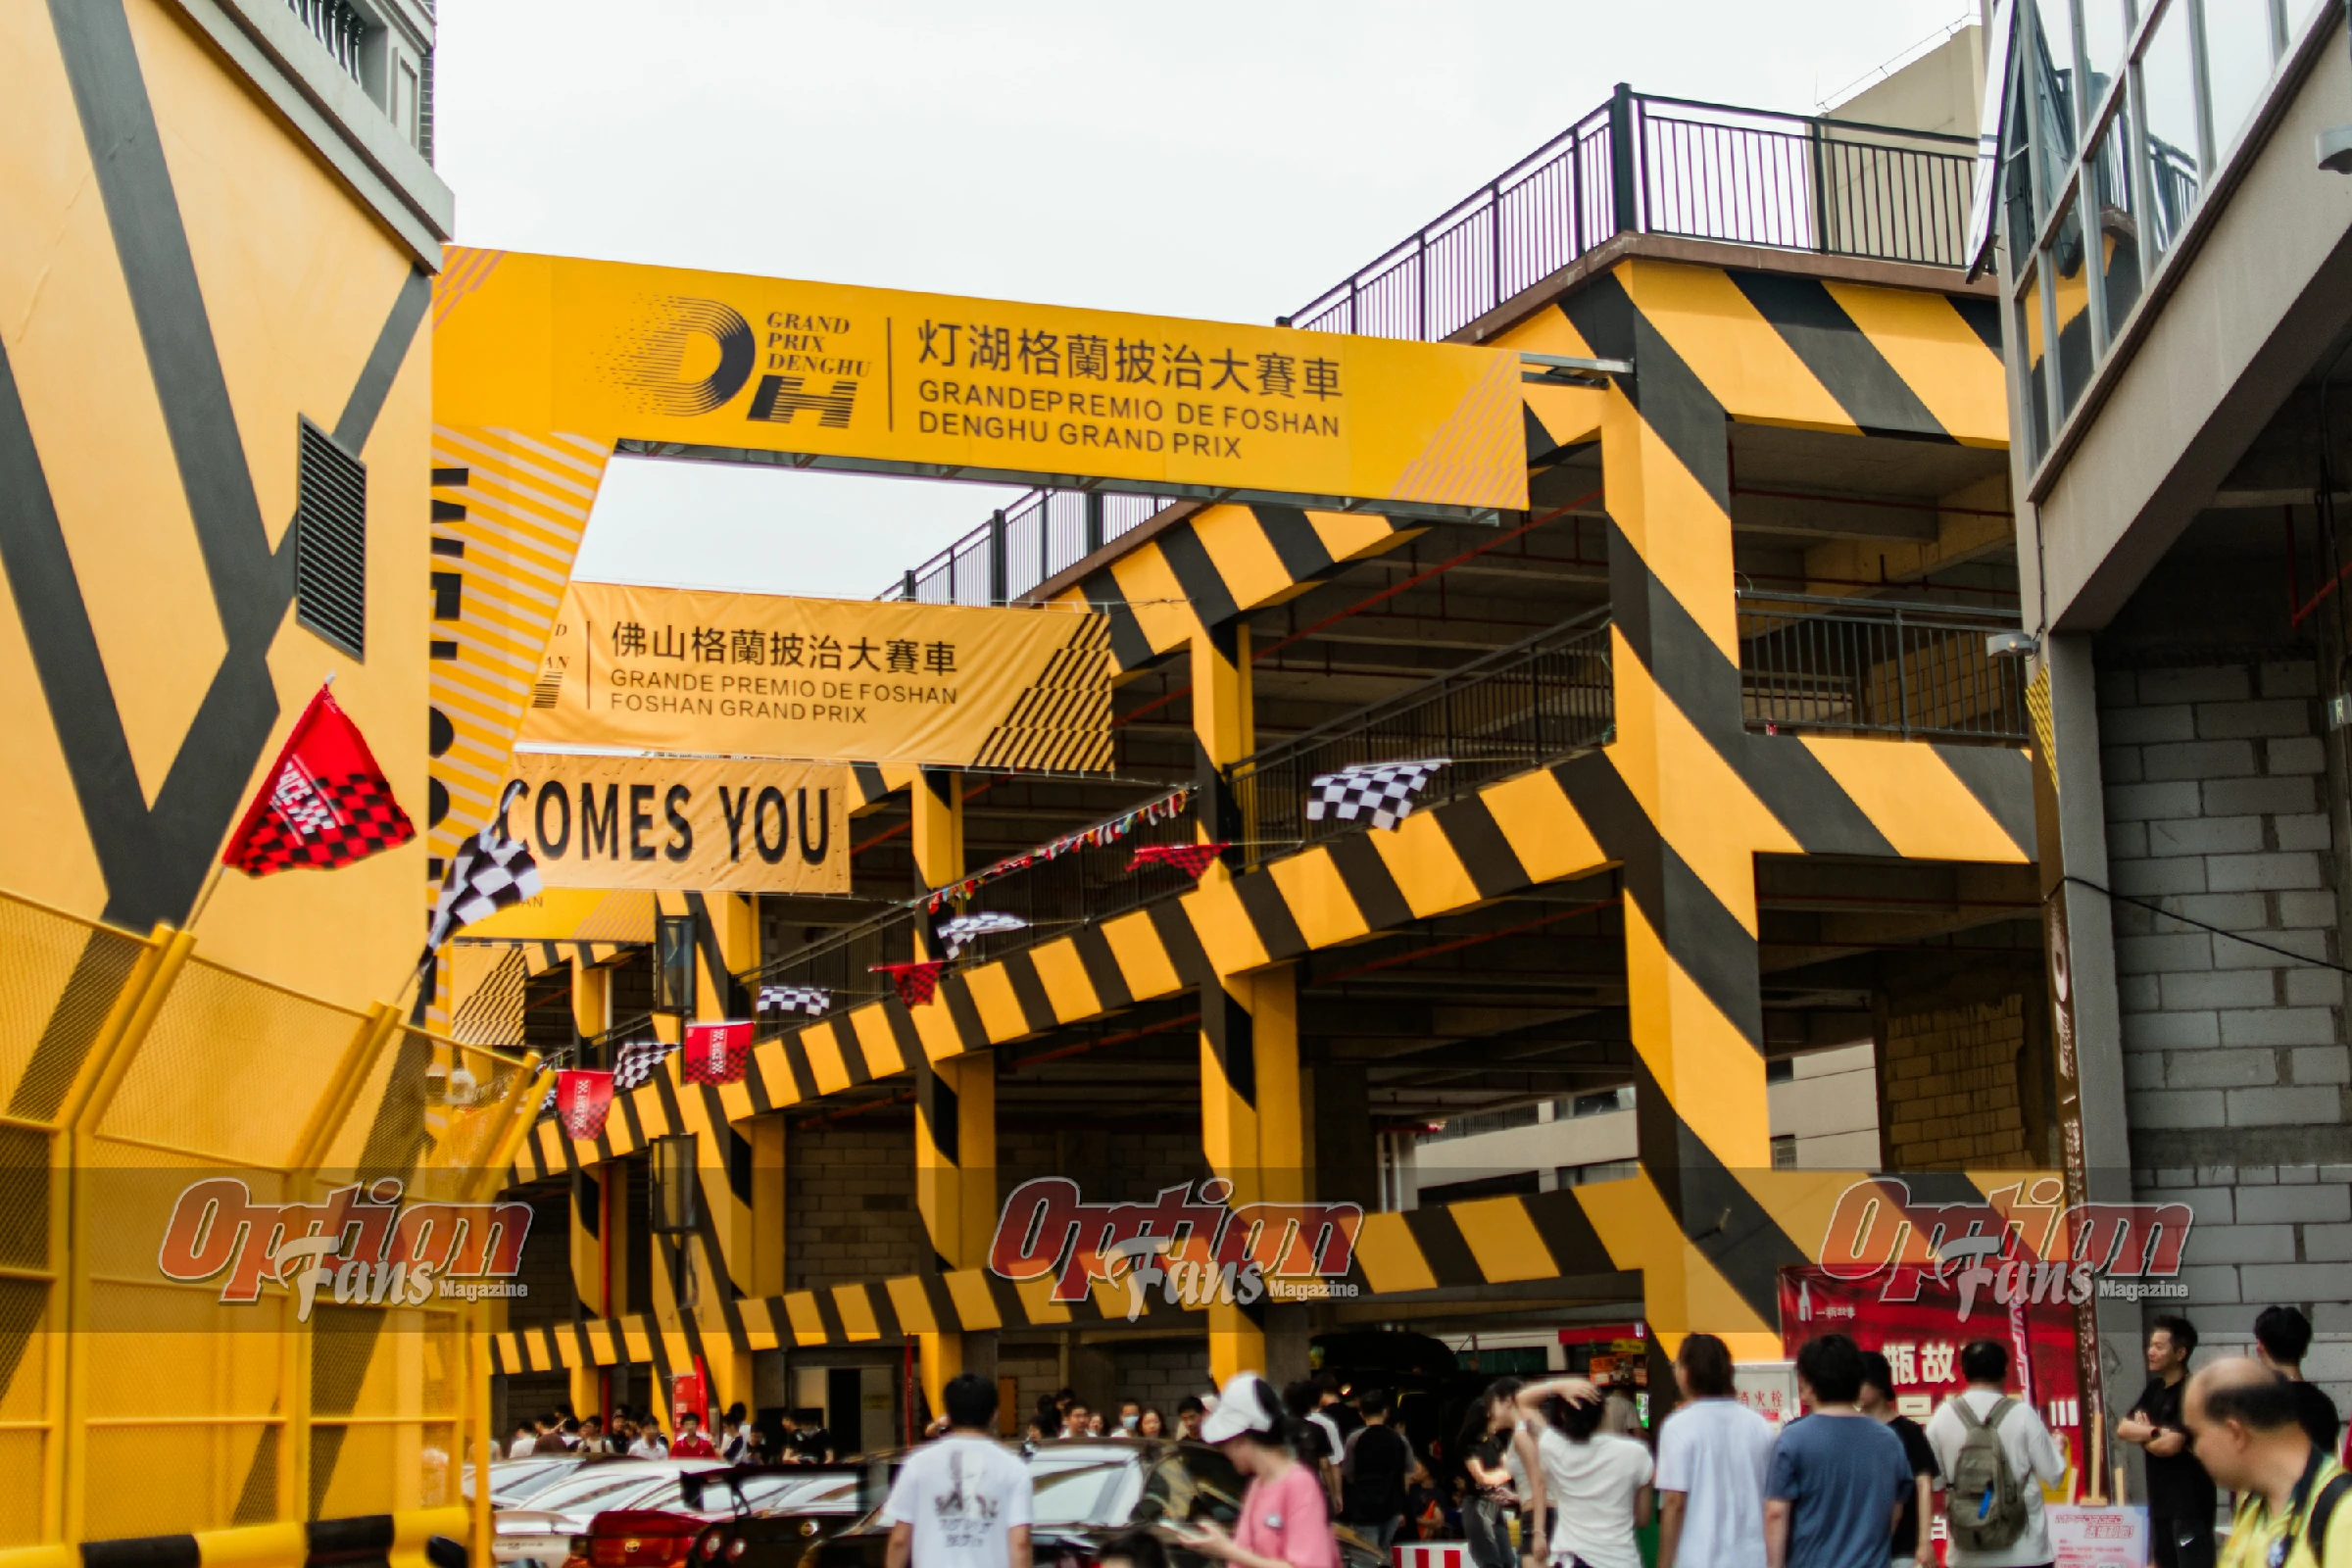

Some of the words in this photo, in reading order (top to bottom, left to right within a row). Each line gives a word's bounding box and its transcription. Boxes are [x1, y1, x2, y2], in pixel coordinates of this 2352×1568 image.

[766, 311, 851, 335] GRAND
[766, 331, 825, 353] PRIX
[766, 352, 872, 378] DENGHU
[918, 318, 1344, 403] 灯湖格蘭披治大賽車
[918, 410, 1049, 442] DENGHU
[1058, 422, 1164, 453] GRAND
[1173, 432, 1242, 460] PRIX
[1177, 401, 1214, 426] DE
[1224, 405, 1339, 437] FOSHAN
[612, 620, 957, 676] 佛山格蘭披治大賽車
[611, 668, 713, 692] GRANDE
[721, 675, 815, 698] PREMIO
[822, 681, 854, 701] DE
[859, 683, 957, 705] FOSHAN
[611, 692, 713, 715] FOSHAN
[720, 699, 807, 720] GRAND
[812, 704, 867, 723] PRIX
[718, 785, 830, 865] YOU
[1738, 1390, 1783, 1408] 消火栓
